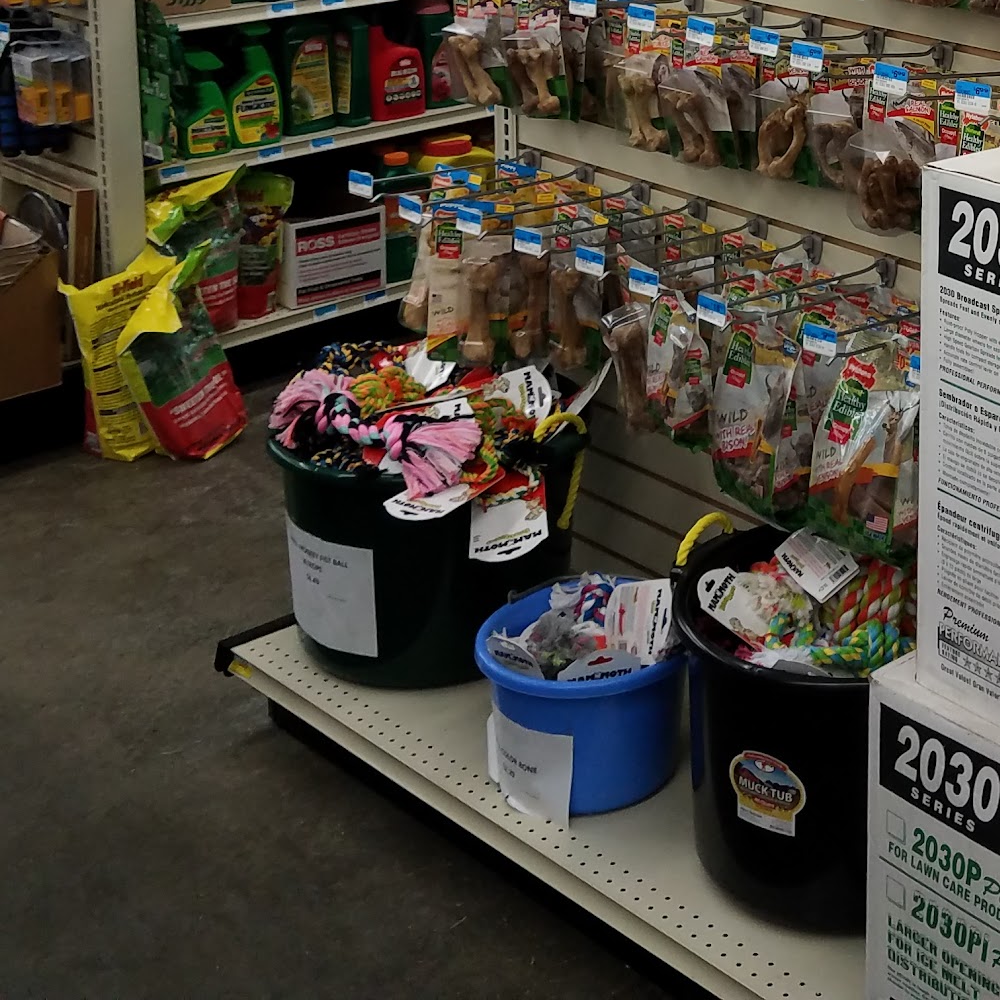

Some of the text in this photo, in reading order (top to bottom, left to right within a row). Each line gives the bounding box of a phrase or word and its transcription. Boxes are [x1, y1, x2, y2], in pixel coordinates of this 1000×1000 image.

[905, 106, 931, 114] SALMON
[939, 111, 960, 120] Healthy
[939, 118, 959, 128] Edibles
[963, 133, 983, 144] Healthy
[297, 236, 335, 253] ROSS
[939, 286, 955, 298] 2030
[956, 291, 990, 312] Broadcast
[939, 365, 975, 386] PROFESSIONAL
[836, 390, 866, 411] Healthy
[720, 408, 748, 424] WILD
[816, 447, 836, 459] WILD
[937, 500, 967, 525] Épandeur
[937, 588, 967, 609] RENDEMENT
[942, 606, 990, 642] Premium
[894, 724, 1000, 824] 2030
[739, 776, 793, 802] MUCK TUB
[910, 786, 976, 834] SERIES
[911, 827, 982, 886] 2030P
[888, 841, 908, 864] FOR
[910, 851, 940, 880] LAWN
[941, 867, 972, 897] CARE
[886, 927, 982, 1000] FOR ICE MELT
[887, 915, 1000, 997] LARGER OPENING
